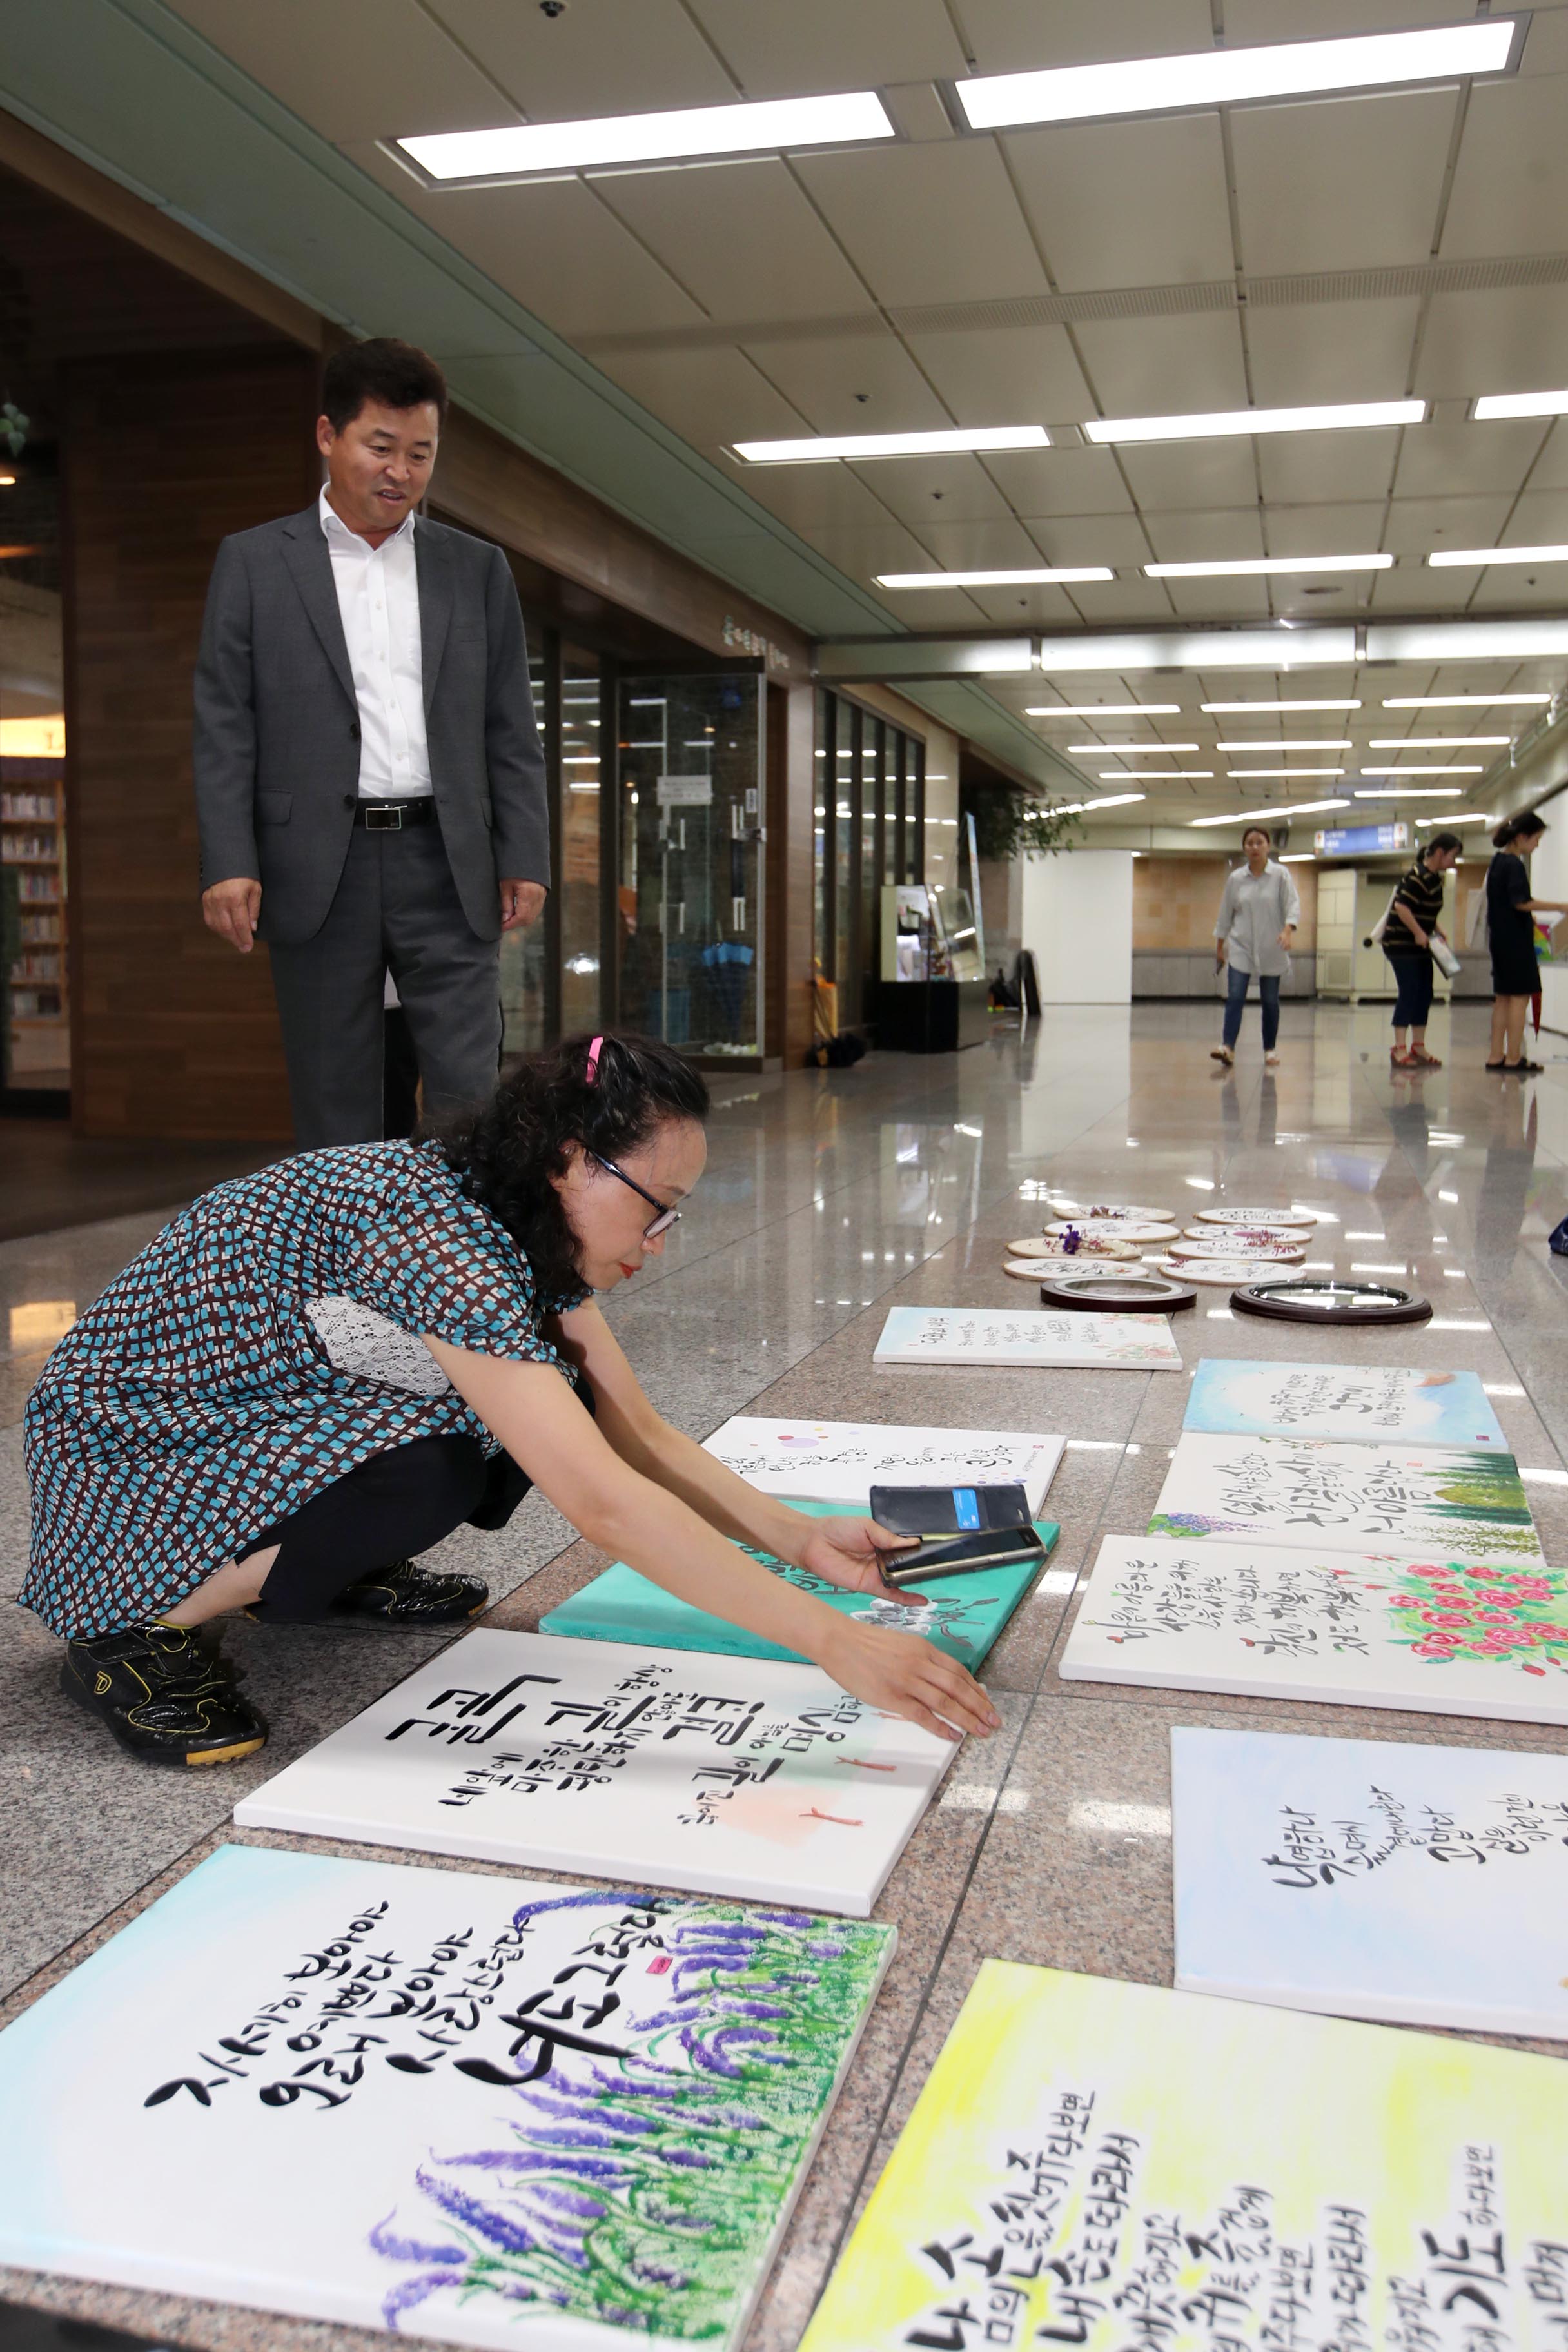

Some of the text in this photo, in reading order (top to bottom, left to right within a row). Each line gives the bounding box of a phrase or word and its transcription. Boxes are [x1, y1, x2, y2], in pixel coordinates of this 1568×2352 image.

[1329, 1385, 1374, 1413] 그것이
[1360, 1460, 1431, 1534] 더 아름답다
[1093, 1560, 1168, 1640] 마음이 아름다운
[1153, 1560, 1201, 1632] 사람들을 위해
[1197, 1576, 1237, 1608] 사랑은
[1233, 1601, 1260, 1628] 제가
[1265, 1572, 1320, 1619] 행복하면
[1318, 1569, 1370, 1655] 저도 행복해요
[384, 1675, 562, 1745] 굴곡
[511, 1665, 672, 1792] 마주한 길이 항상
[557, 1692, 698, 1791] 평탄하지 않아도
[663, 1696, 765, 1745] 결코
[780, 1696, 863, 1752] 명심하
[692, 1756, 785, 1786] 길이
[749, 1723, 789, 1749] 아님을
[1333, 1821, 1395, 1869] 슬며시
[1421, 1805, 1486, 1864] 고맙다
[144, 1901, 389, 2108] 자세히 보아야
[259, 1928, 473, 2109] 오래 보아야
[287, 1951, 402, 2051] 예쁘다
[386, 1917, 534, 2074] 사랑스럽다
[1037, 2134, 1139, 2344] 내 손도 따라서
[1185, 2188, 1271, 2262] 즐겁게
[1327, 2205, 1369, 2306] 따라서
[905, 2284, 1030, 2352] 남의
[1184, 2273, 1255, 2327] 귀를
